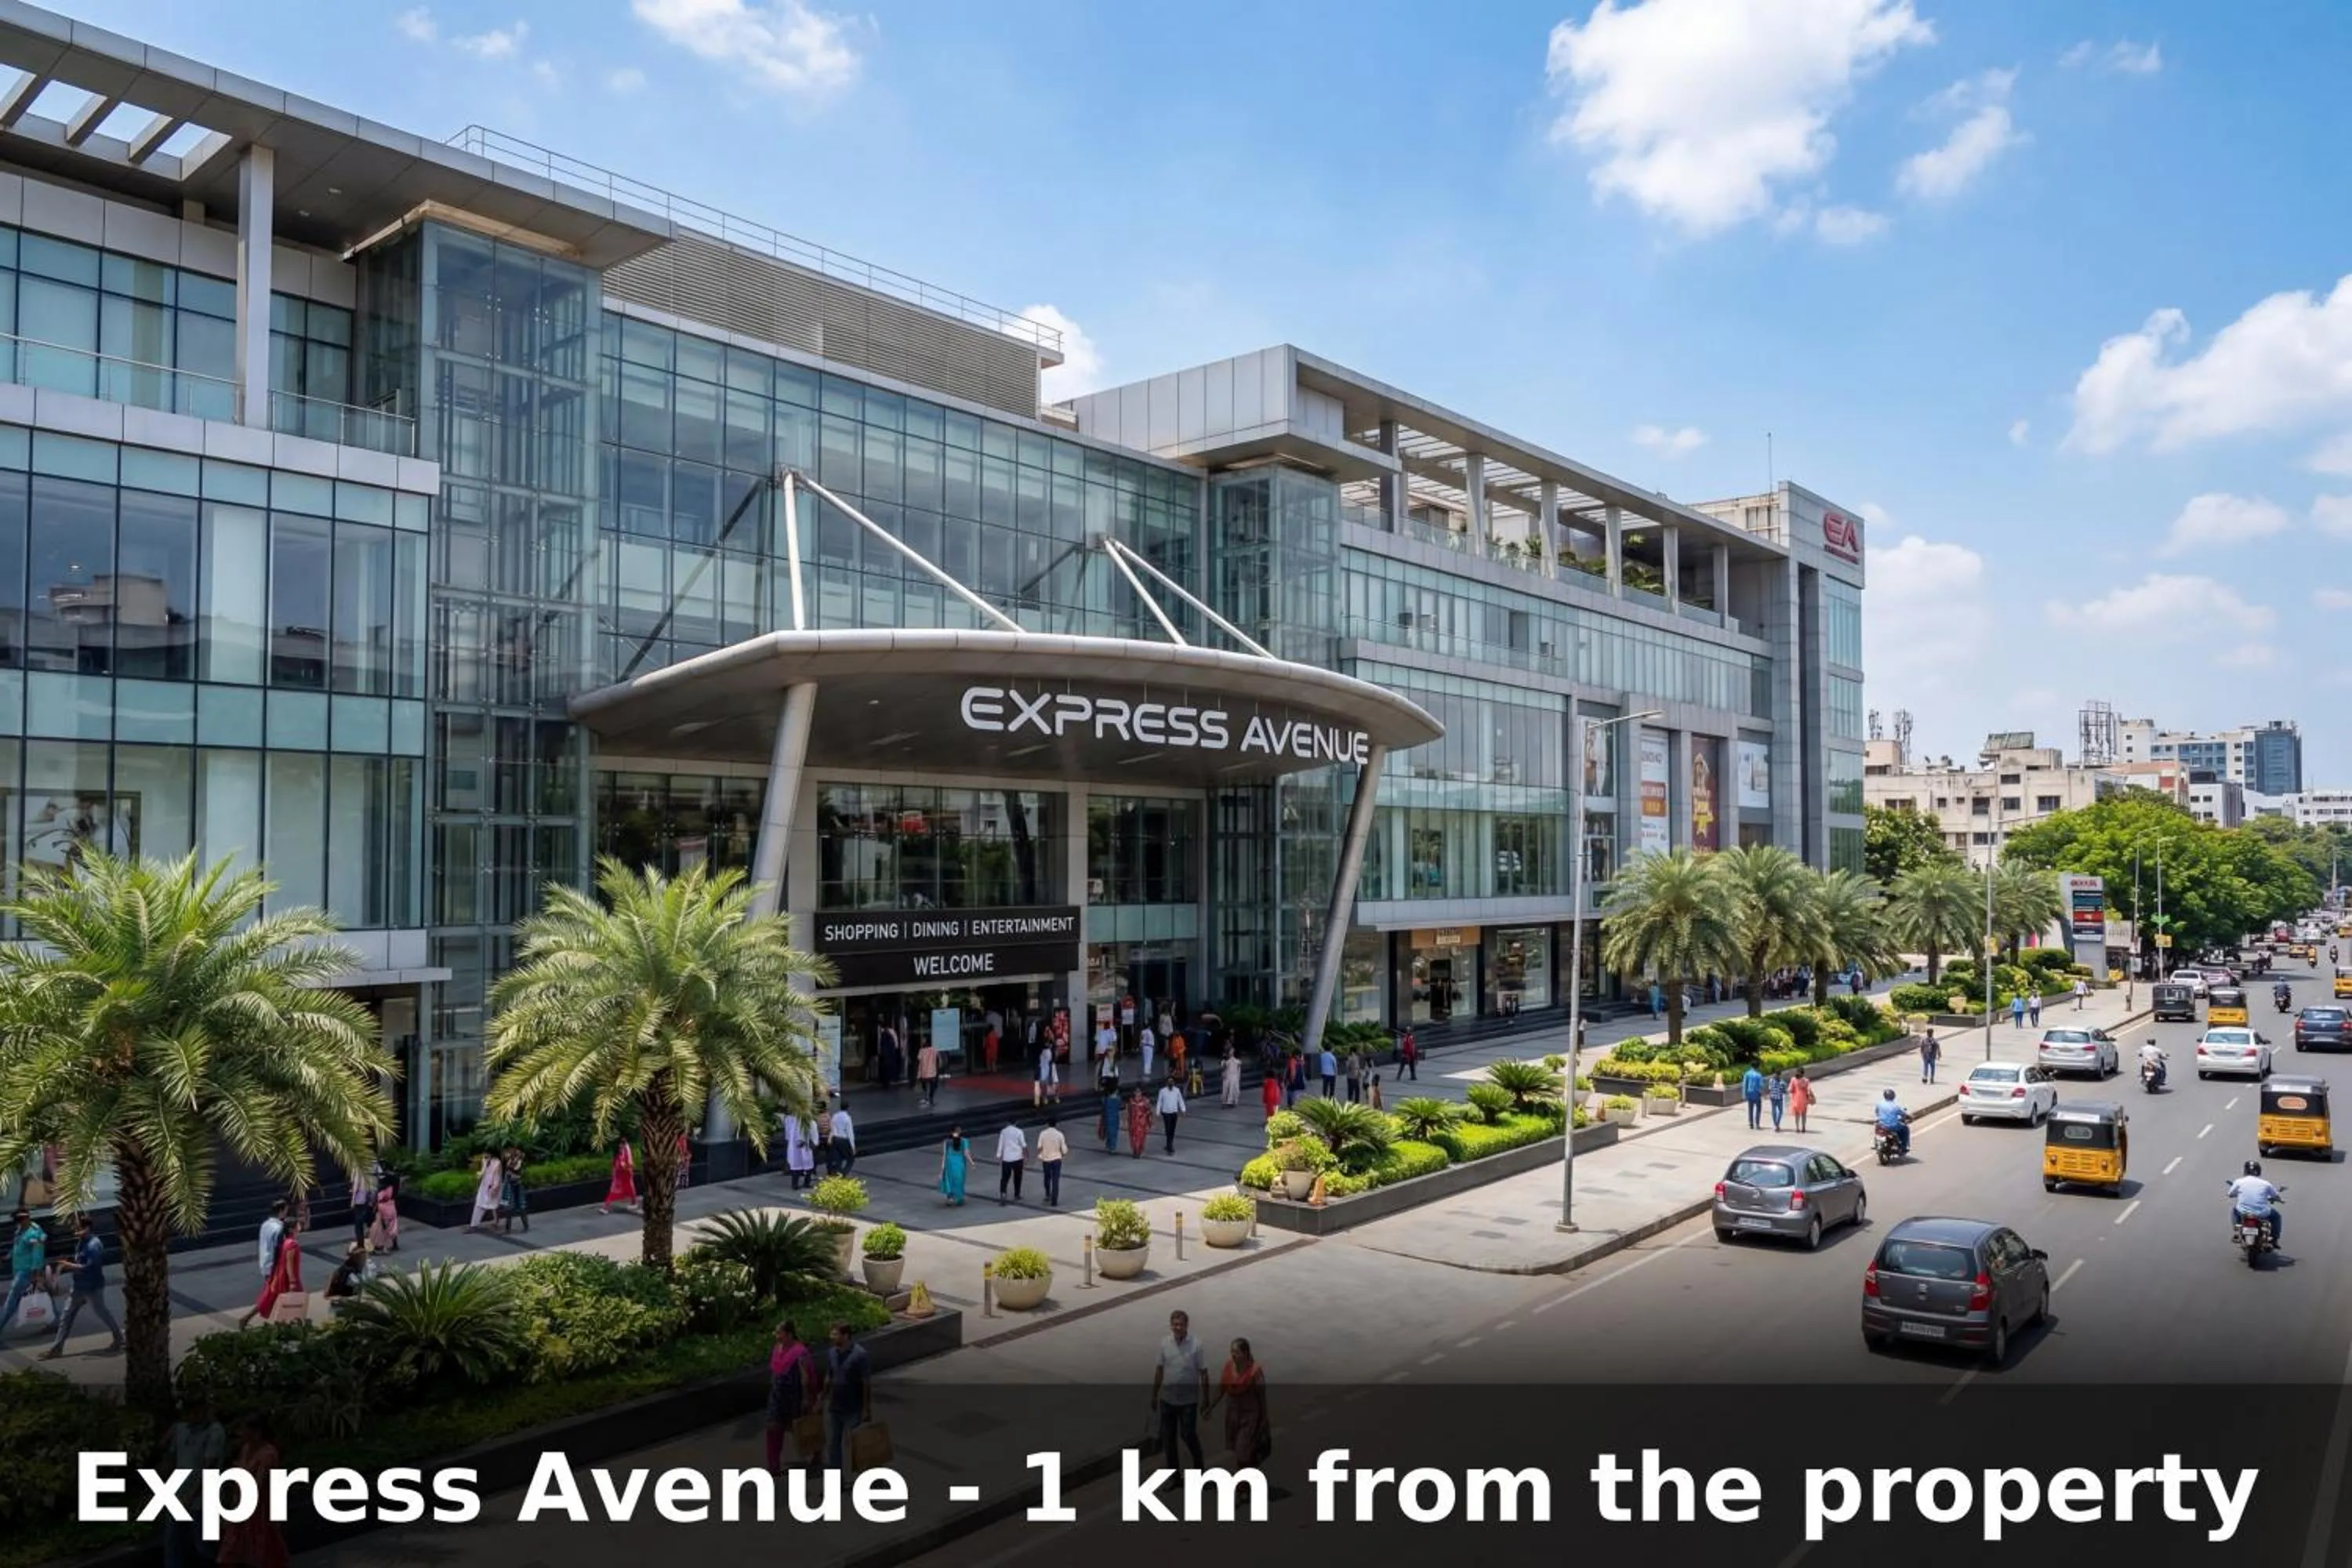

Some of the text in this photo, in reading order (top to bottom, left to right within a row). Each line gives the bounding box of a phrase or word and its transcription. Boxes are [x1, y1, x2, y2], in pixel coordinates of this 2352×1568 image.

[960, 687, 1369, 765] EXPRESS AVENUE
[825, 923, 898, 942] SHOPPING
[913, 920, 959, 938] DINING
[972, 916, 1075, 935] ENTERTAINMENT
[913, 953, 994, 975] WELCOME
